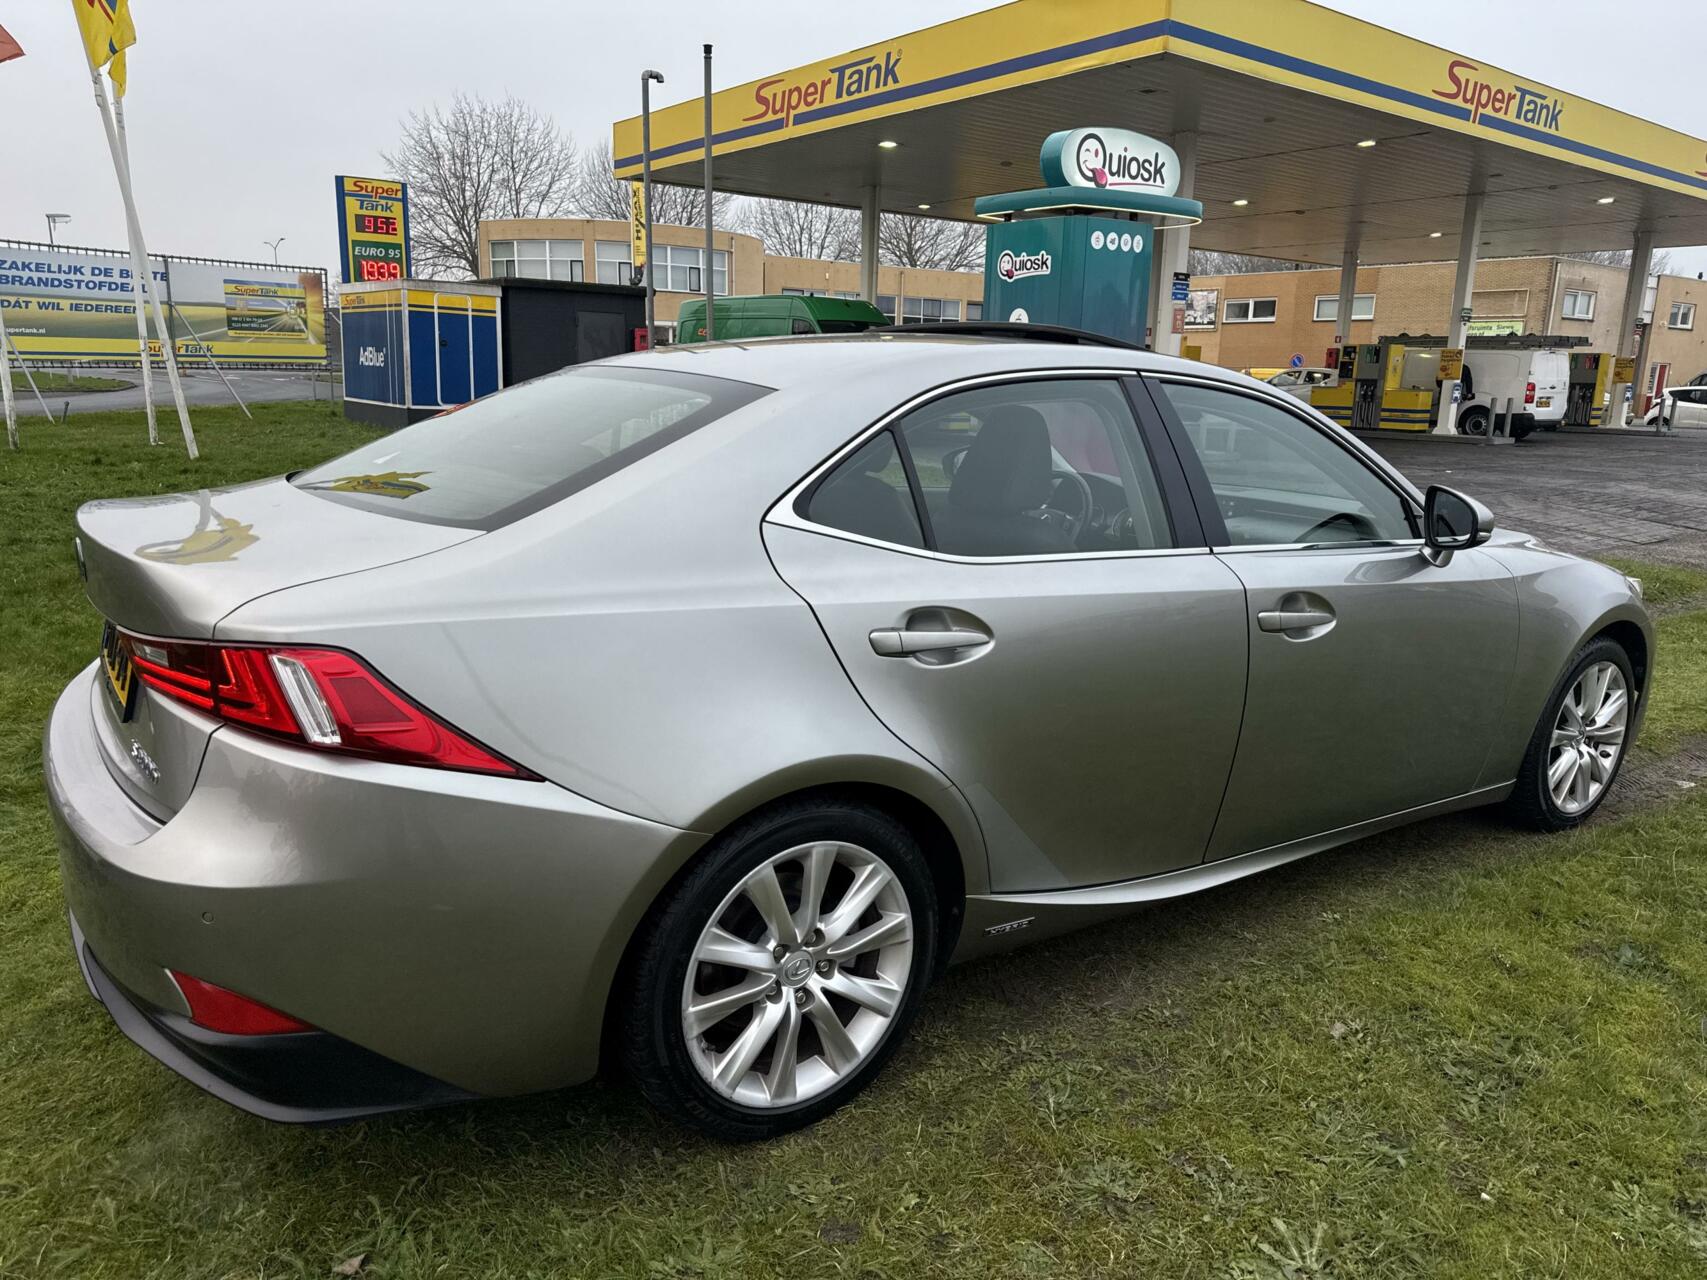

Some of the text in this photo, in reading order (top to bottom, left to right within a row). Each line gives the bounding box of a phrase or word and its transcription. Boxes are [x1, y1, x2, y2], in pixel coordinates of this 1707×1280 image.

[742, 51, 903, 128] SuperTank
[1432, 60, 1564, 131] SuperTank
[1076, 133, 1166, 188] Quiosk
[345, 180, 402, 199] Super
[354, 199, 394, 213] Tank
[354, 246, 401, 258] EURO 95
[0, 259, 85, 276] ZAKELIJK
[91, 266, 114, 278] DE
[999, 252, 1050, 279] Quiosk
[37, 301, 65, 311] WIL
[359, 346, 385, 368] AdBlue
